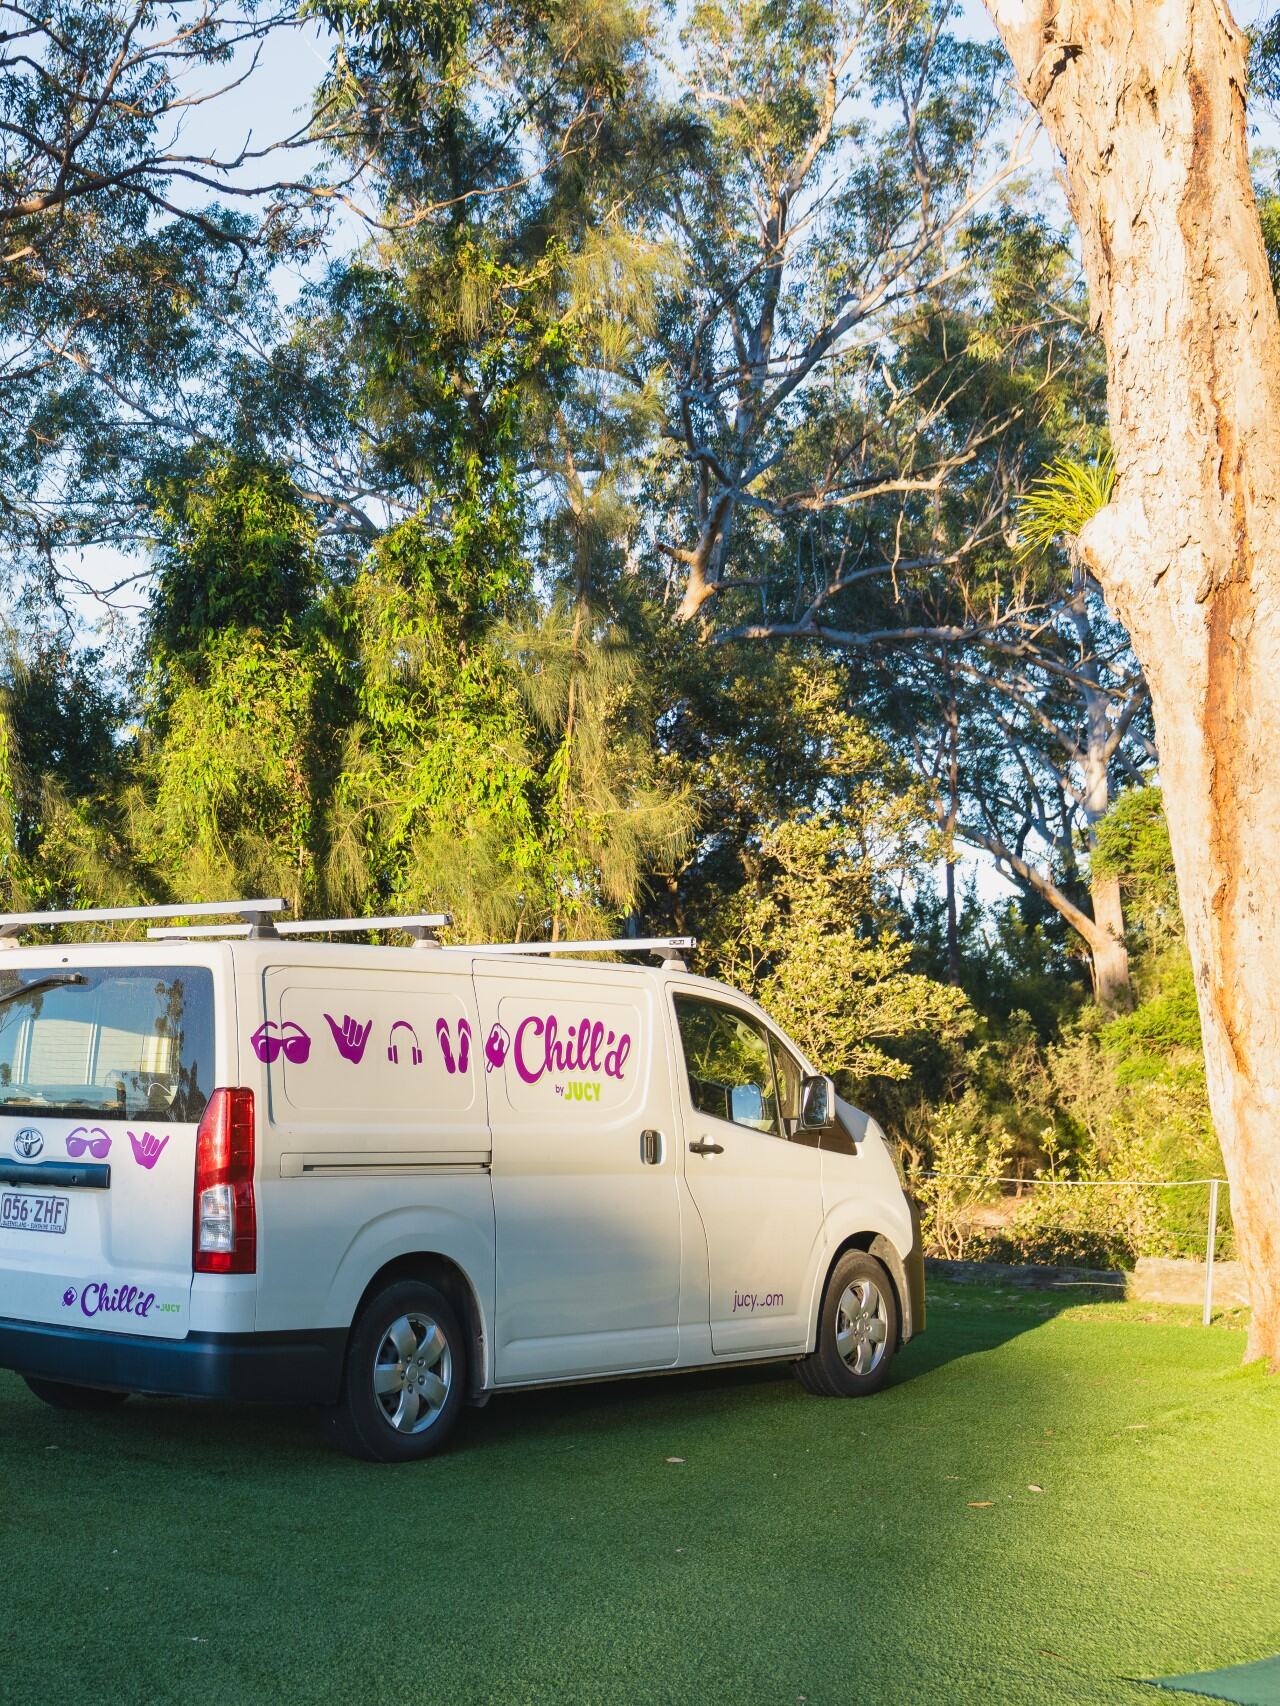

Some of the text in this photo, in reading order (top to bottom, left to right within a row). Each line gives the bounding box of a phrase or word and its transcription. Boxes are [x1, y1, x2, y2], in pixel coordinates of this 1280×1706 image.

[514, 1014, 631, 1084] Chill'd
[555, 1081, 601, 1102] by JUCY
[80, 1282, 181, 1317] Chill'd JUCY
